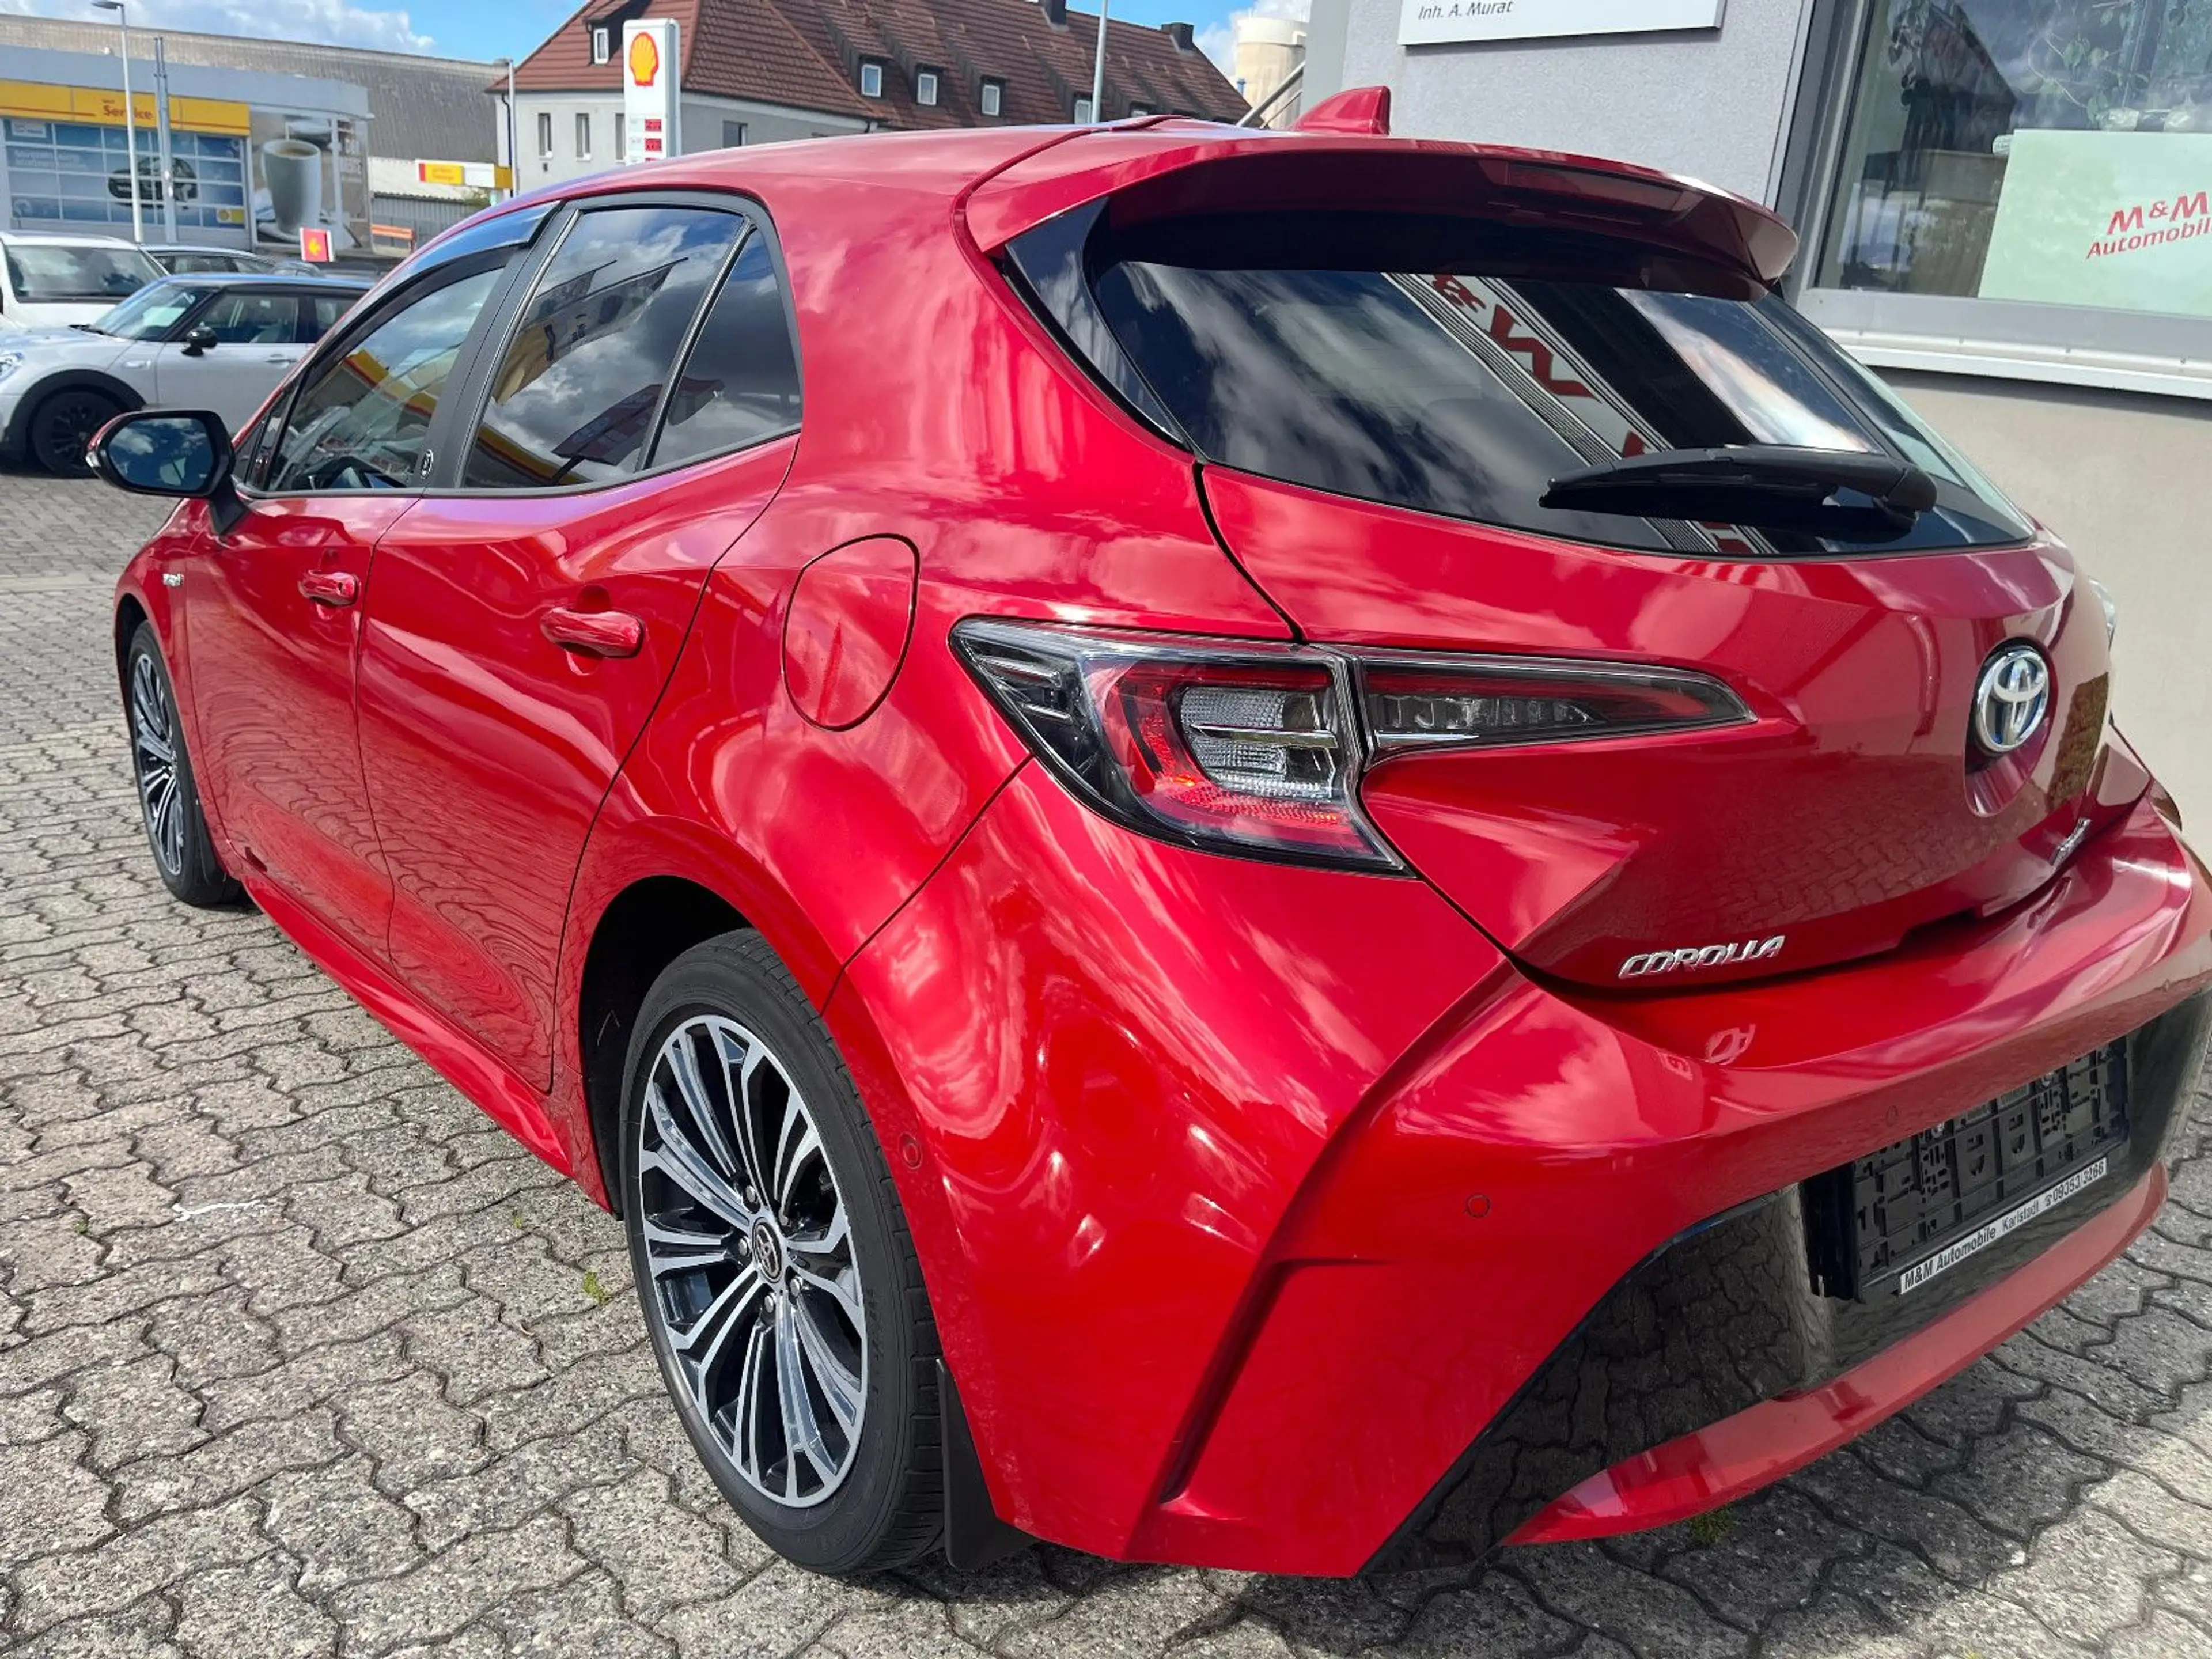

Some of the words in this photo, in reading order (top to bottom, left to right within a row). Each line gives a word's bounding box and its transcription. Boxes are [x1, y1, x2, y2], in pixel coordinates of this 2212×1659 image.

[1418, 5, 1444, 20] Inh.
[1448, 3, 1463, 18] A.
[1467, 0, 1515, 16] Murat
[2085, 216, 2212, 260] Automobil
[1617, 934, 1786, 979] COROLLA
[1904, 1259, 1934, 1290] M&M
[1936, 1226, 1997, 1272] Automobile
[2002, 1199, 2039, 1232] Karlstadt
